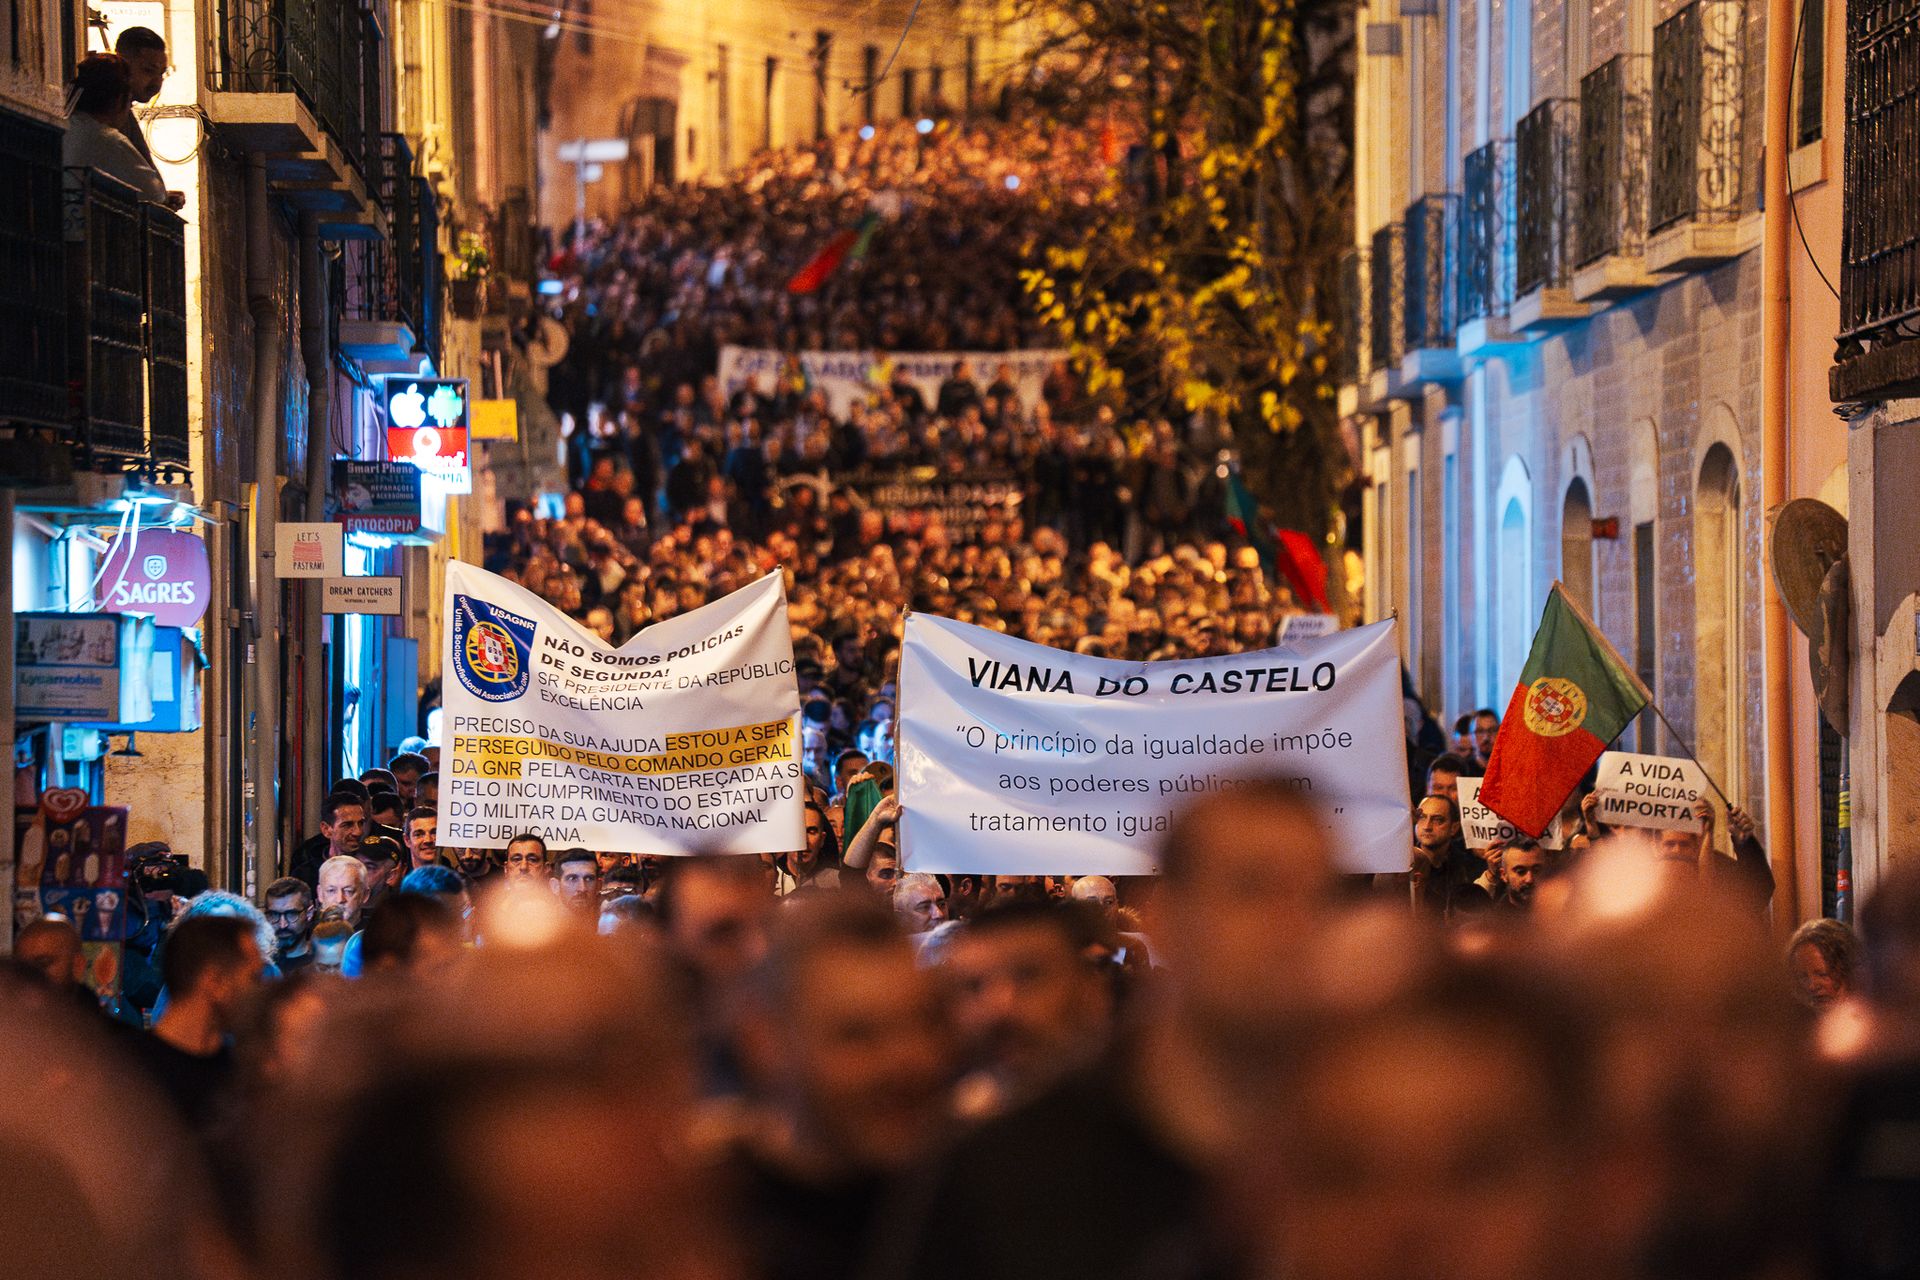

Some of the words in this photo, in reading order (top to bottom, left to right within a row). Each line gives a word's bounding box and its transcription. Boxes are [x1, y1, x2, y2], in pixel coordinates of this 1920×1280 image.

[347, 462, 380, 474] Smart
[381, 462, 414, 474] Phone
[297, 532, 320, 542] LET'S
[293, 561, 325, 571] PASTRAMI
[115, 580, 196, 606] SAGRES
[330, 586, 353, 596] DREAM
[357, 587, 393, 596] CATCHERS
[489, 606, 536, 631] USAGNR
[544, 635, 585, 658] NÃO
[591, 651, 662, 666] SOMOS
[541, 653, 565, 671] DE
[570, 665, 670, 682] SEGUNDA!
[968, 657, 1075, 694] VIANA
[1095, 676, 1149, 697] DO
[1170, 662, 1336, 695] CASTELO
[537, 672, 560, 688] SR
[564, 678, 673, 695] PRESIDENTE
[678, 674, 701, 689] DA
[540, 688, 644, 711] EXCELÊNCIA
[454, 716, 536, 734] PRECISO
[539, 724, 561, 742] DA
[563, 731, 598, 749] SUA
[600, 738, 661, 753] AJUDA
[665, 732, 729, 752] ESTOU
[734, 729, 748, 743] A
[751, 722, 789, 741] SER
[995, 728, 1097, 758] princípio
[1105, 734, 1134, 755] da
[1144, 734, 1265, 760] igualdade
[1273, 728, 1353, 755] impõe
[453, 738, 572, 760] PERSEGUIDO
[575, 751, 620, 770] PELO
[625, 752, 724, 772] COMANDO
[729, 743, 792, 763] GERAL
[452, 759, 478, 774] DA
[483, 760, 522, 776] GNR
[528, 762, 576, 778] PELA
[579, 768, 634, 789] CARTA
[637, 766, 768, 792] ENDEREÇADA
[770, 765, 784, 780] A
[1620, 761, 1633, 775] A
[1640, 762, 1685, 782] VIDA
[451, 780, 501, 797] PELO
[506, 782, 659, 810] INCUMPRIMENTO
[664, 795, 692, 811] DO
[697, 784, 794, 808] ESTATUTO
[999, 774, 1041, 790] aos
[1049, 774, 1150, 795] poderes
[1159, 774, 1267, 795] públic
[1624, 782, 1698, 802] POLÍCIAS
[450, 801, 478, 817] DO
[483, 803, 555, 820] MILITAR
[561, 806, 587, 821] DA
[592, 807, 669, 829] GUARDA
[671, 809, 768, 830] NACIONAL
[1462, 807, 1490, 820] PSP
[1604, 797, 1693, 820] IMPORTA
[449, 823, 586, 843] REPUBLICANA.
[969, 812, 1107, 832] tratamento
[1117, 811, 1174, 837] igual
[1471, 825, 1553, 841] IMPOA
